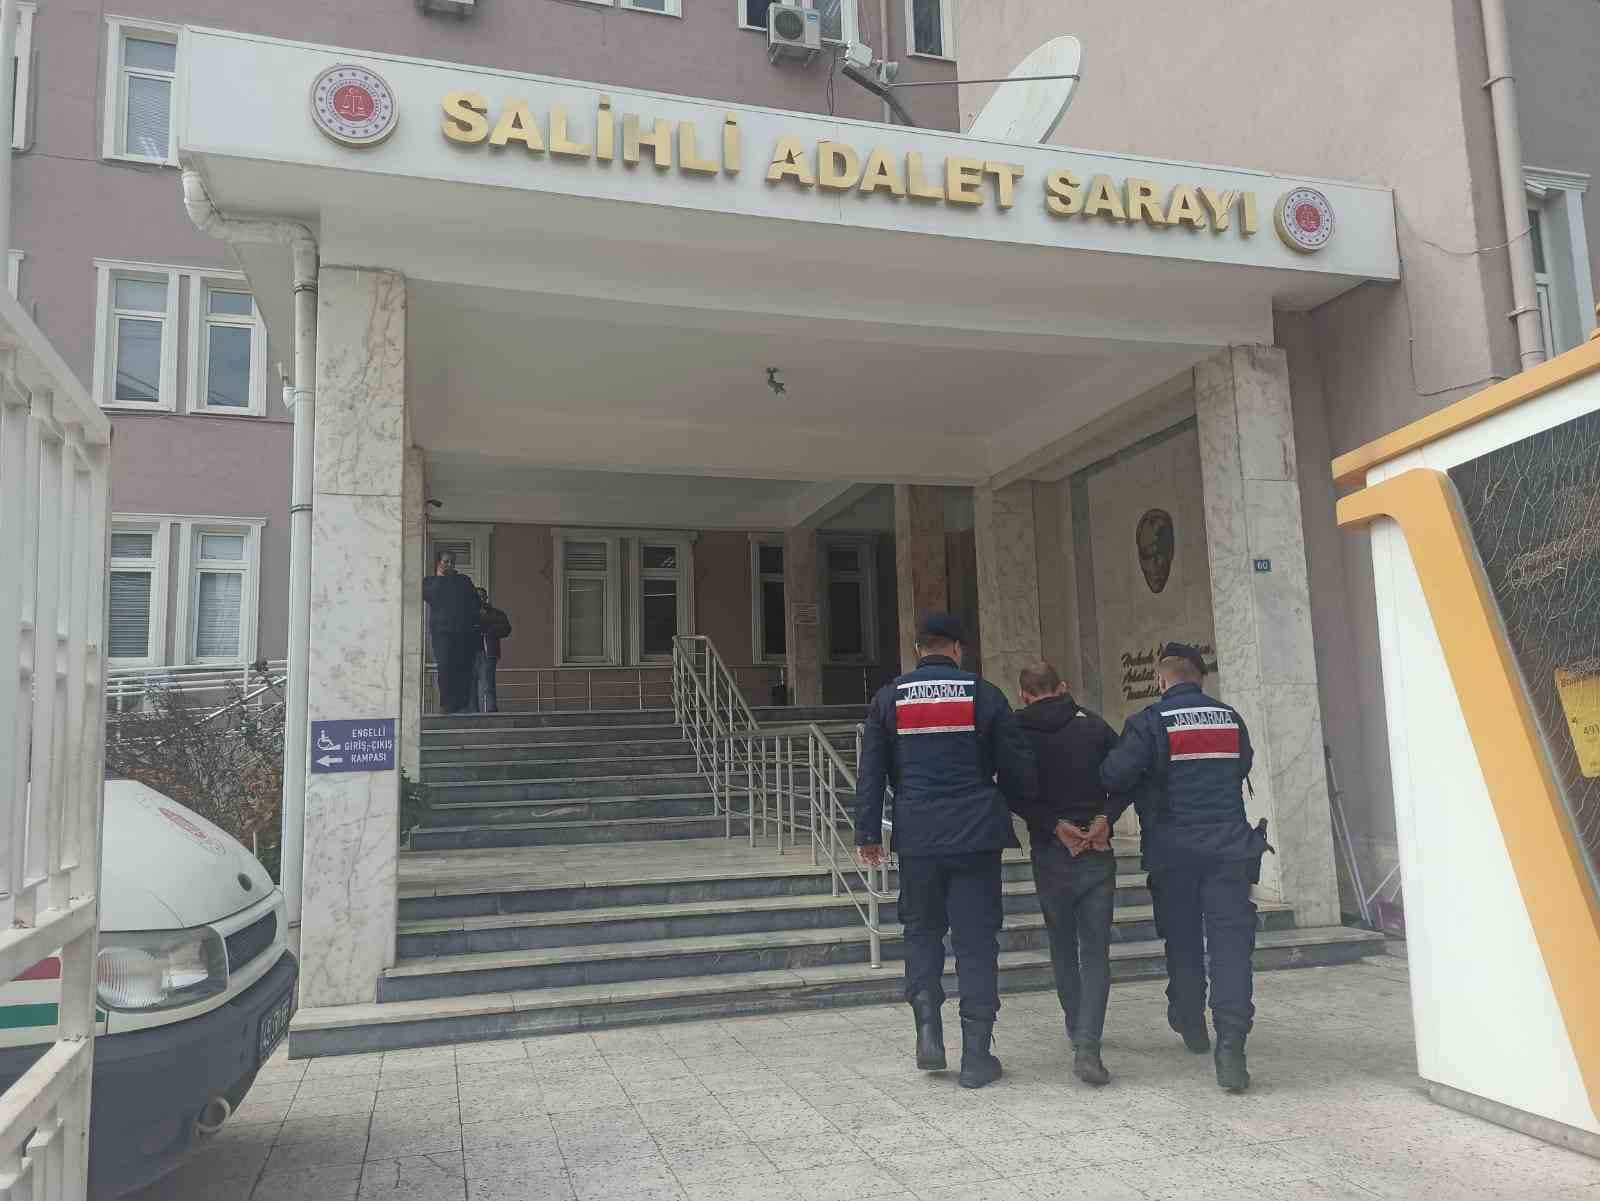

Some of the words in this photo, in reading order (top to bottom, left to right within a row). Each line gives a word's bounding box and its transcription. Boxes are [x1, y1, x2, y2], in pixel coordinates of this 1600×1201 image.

[441, 91, 741, 176] SALİHLİ
[767, 135, 1025, 209] ADALET
[1046, 170, 1257, 238] SARAYI
[904, 685, 966, 702] JANDARMA
[1174, 711, 1232, 727] JANDARMA
